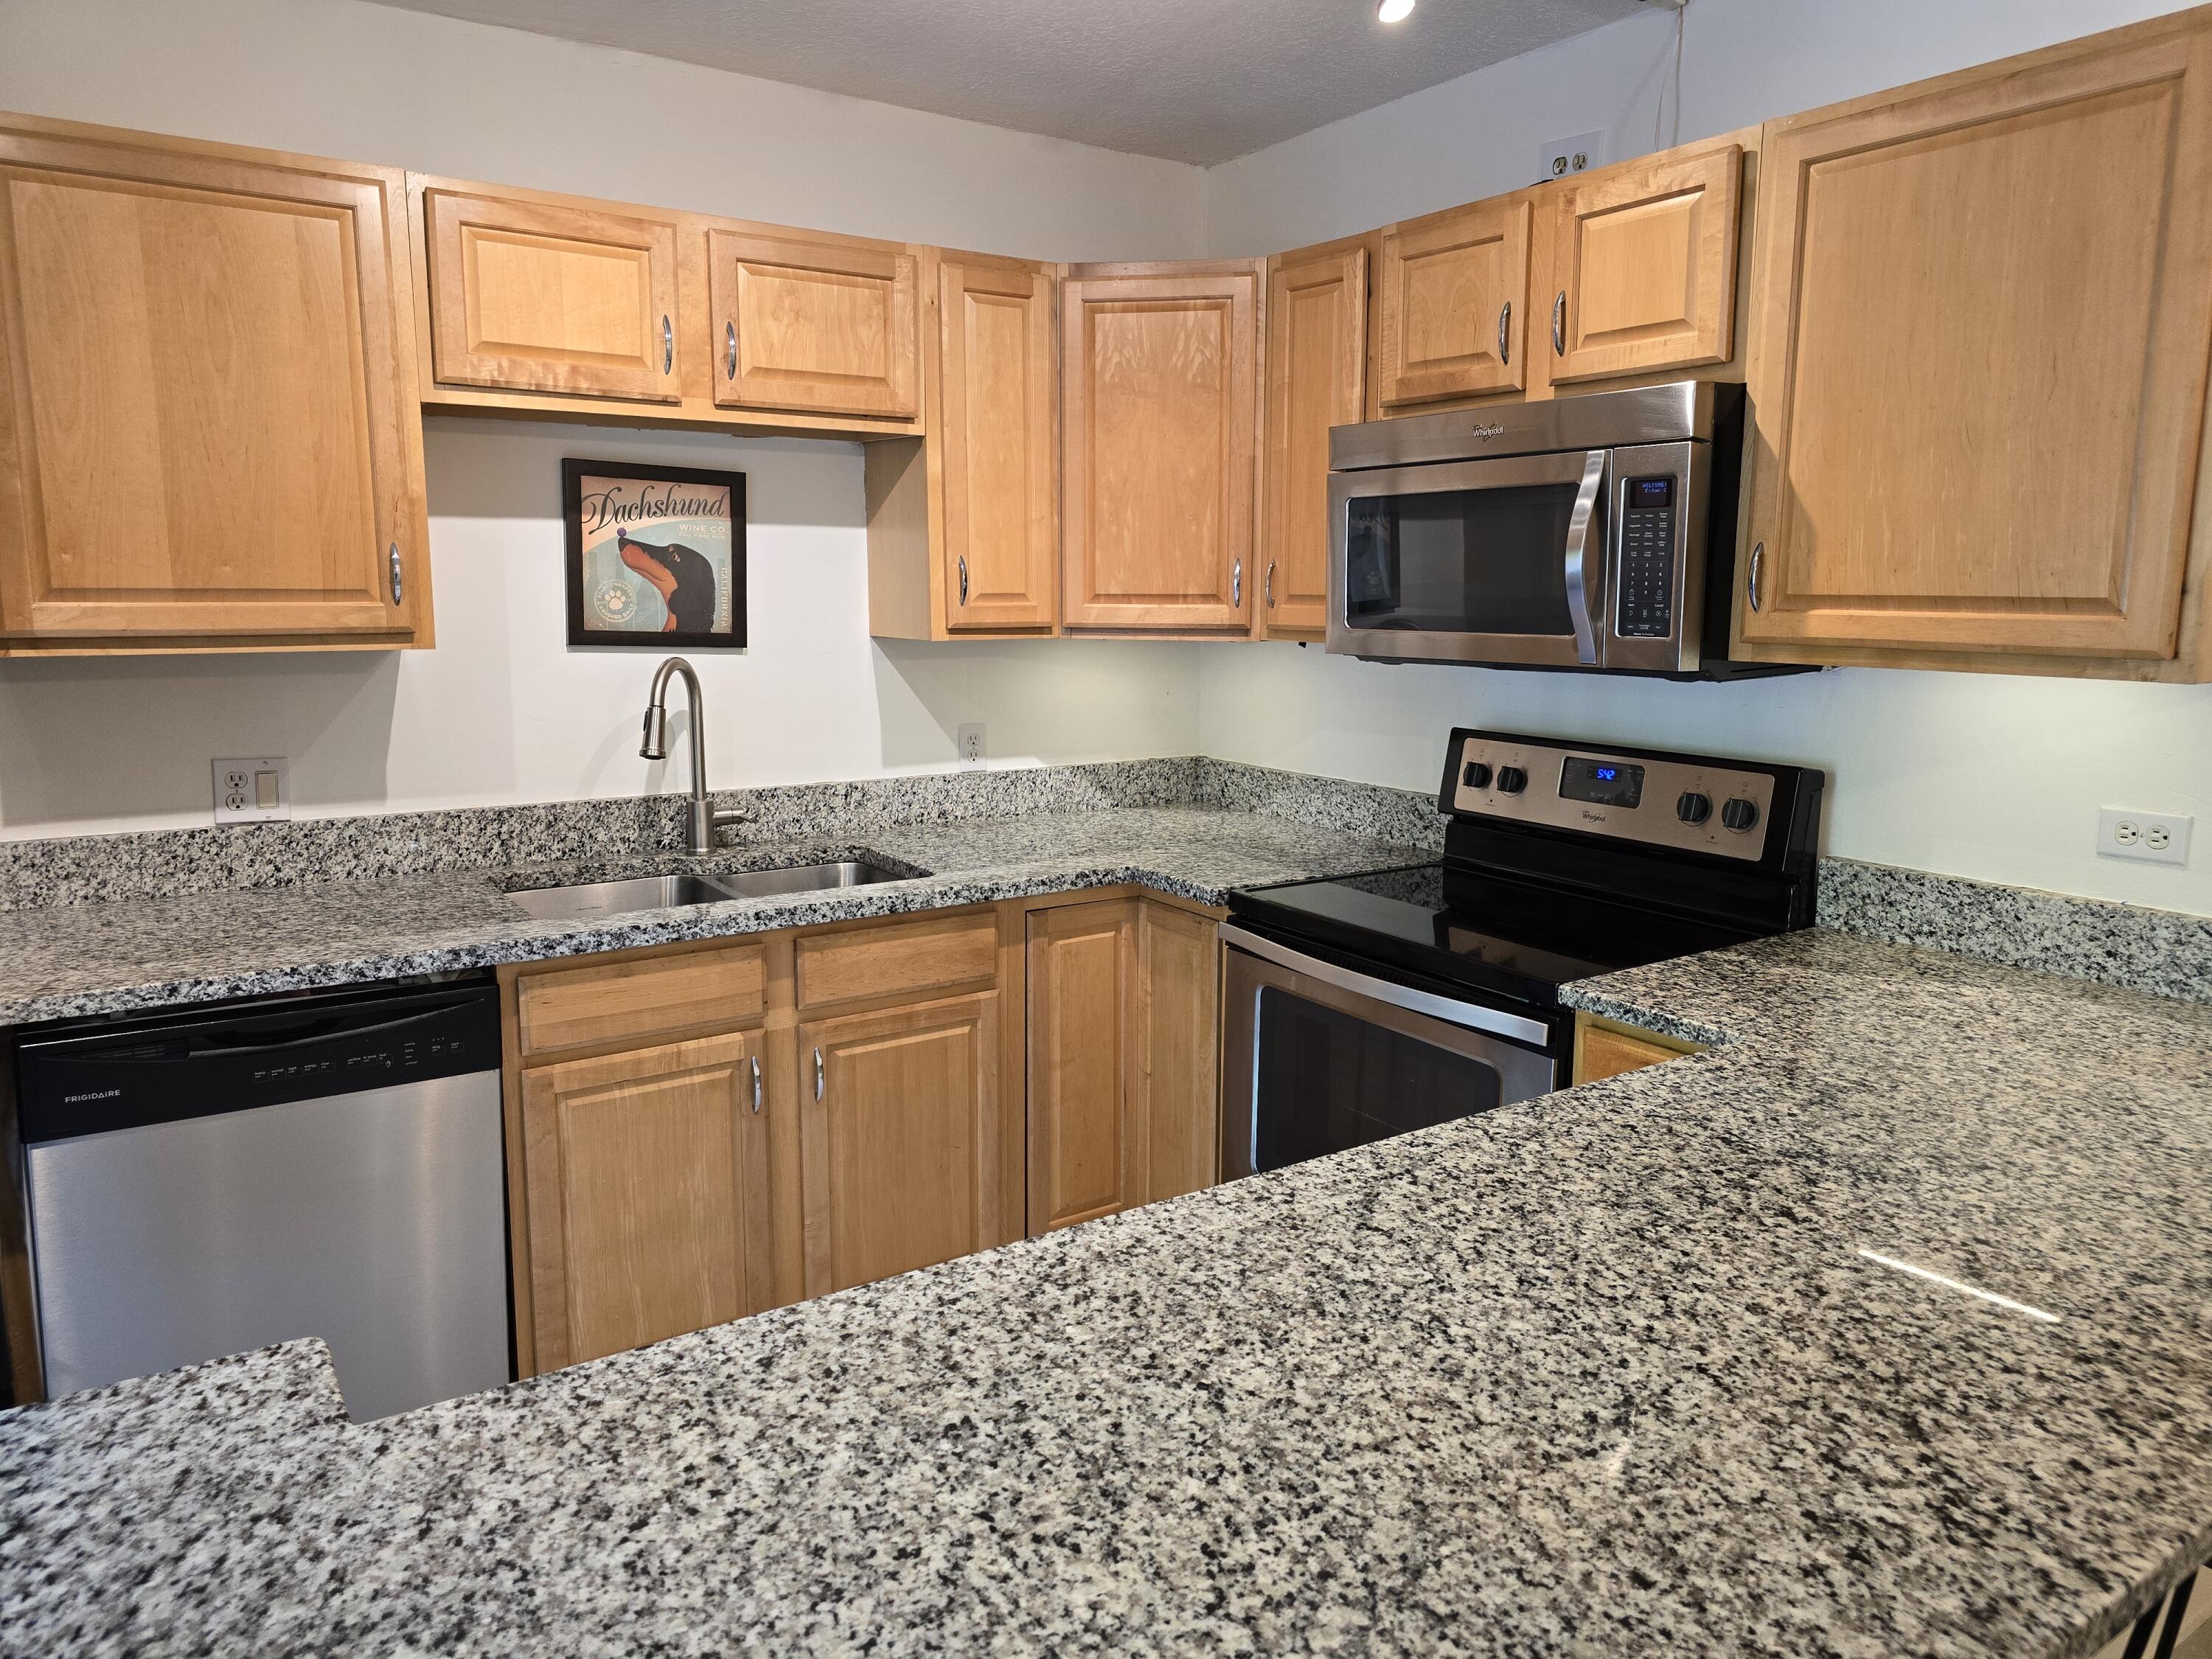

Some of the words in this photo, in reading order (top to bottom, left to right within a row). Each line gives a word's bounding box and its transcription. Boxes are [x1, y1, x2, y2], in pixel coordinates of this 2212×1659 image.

[1472, 423, 1503, 440] Whirlpool
[581, 484, 730, 535] Dachshund
[678, 524, 708, 532] WINE
[720, 566, 728, 627] CALIFORNIA
[599, 605, 622, 619] CRUSHED
[622, 603, 634, 618] DAILY
[1597, 768, 1615, 780] 5:42
[1582, 811, 1606, 822] Whirlpool
[65, 1089, 121, 1103] FRIGIDAIRE
